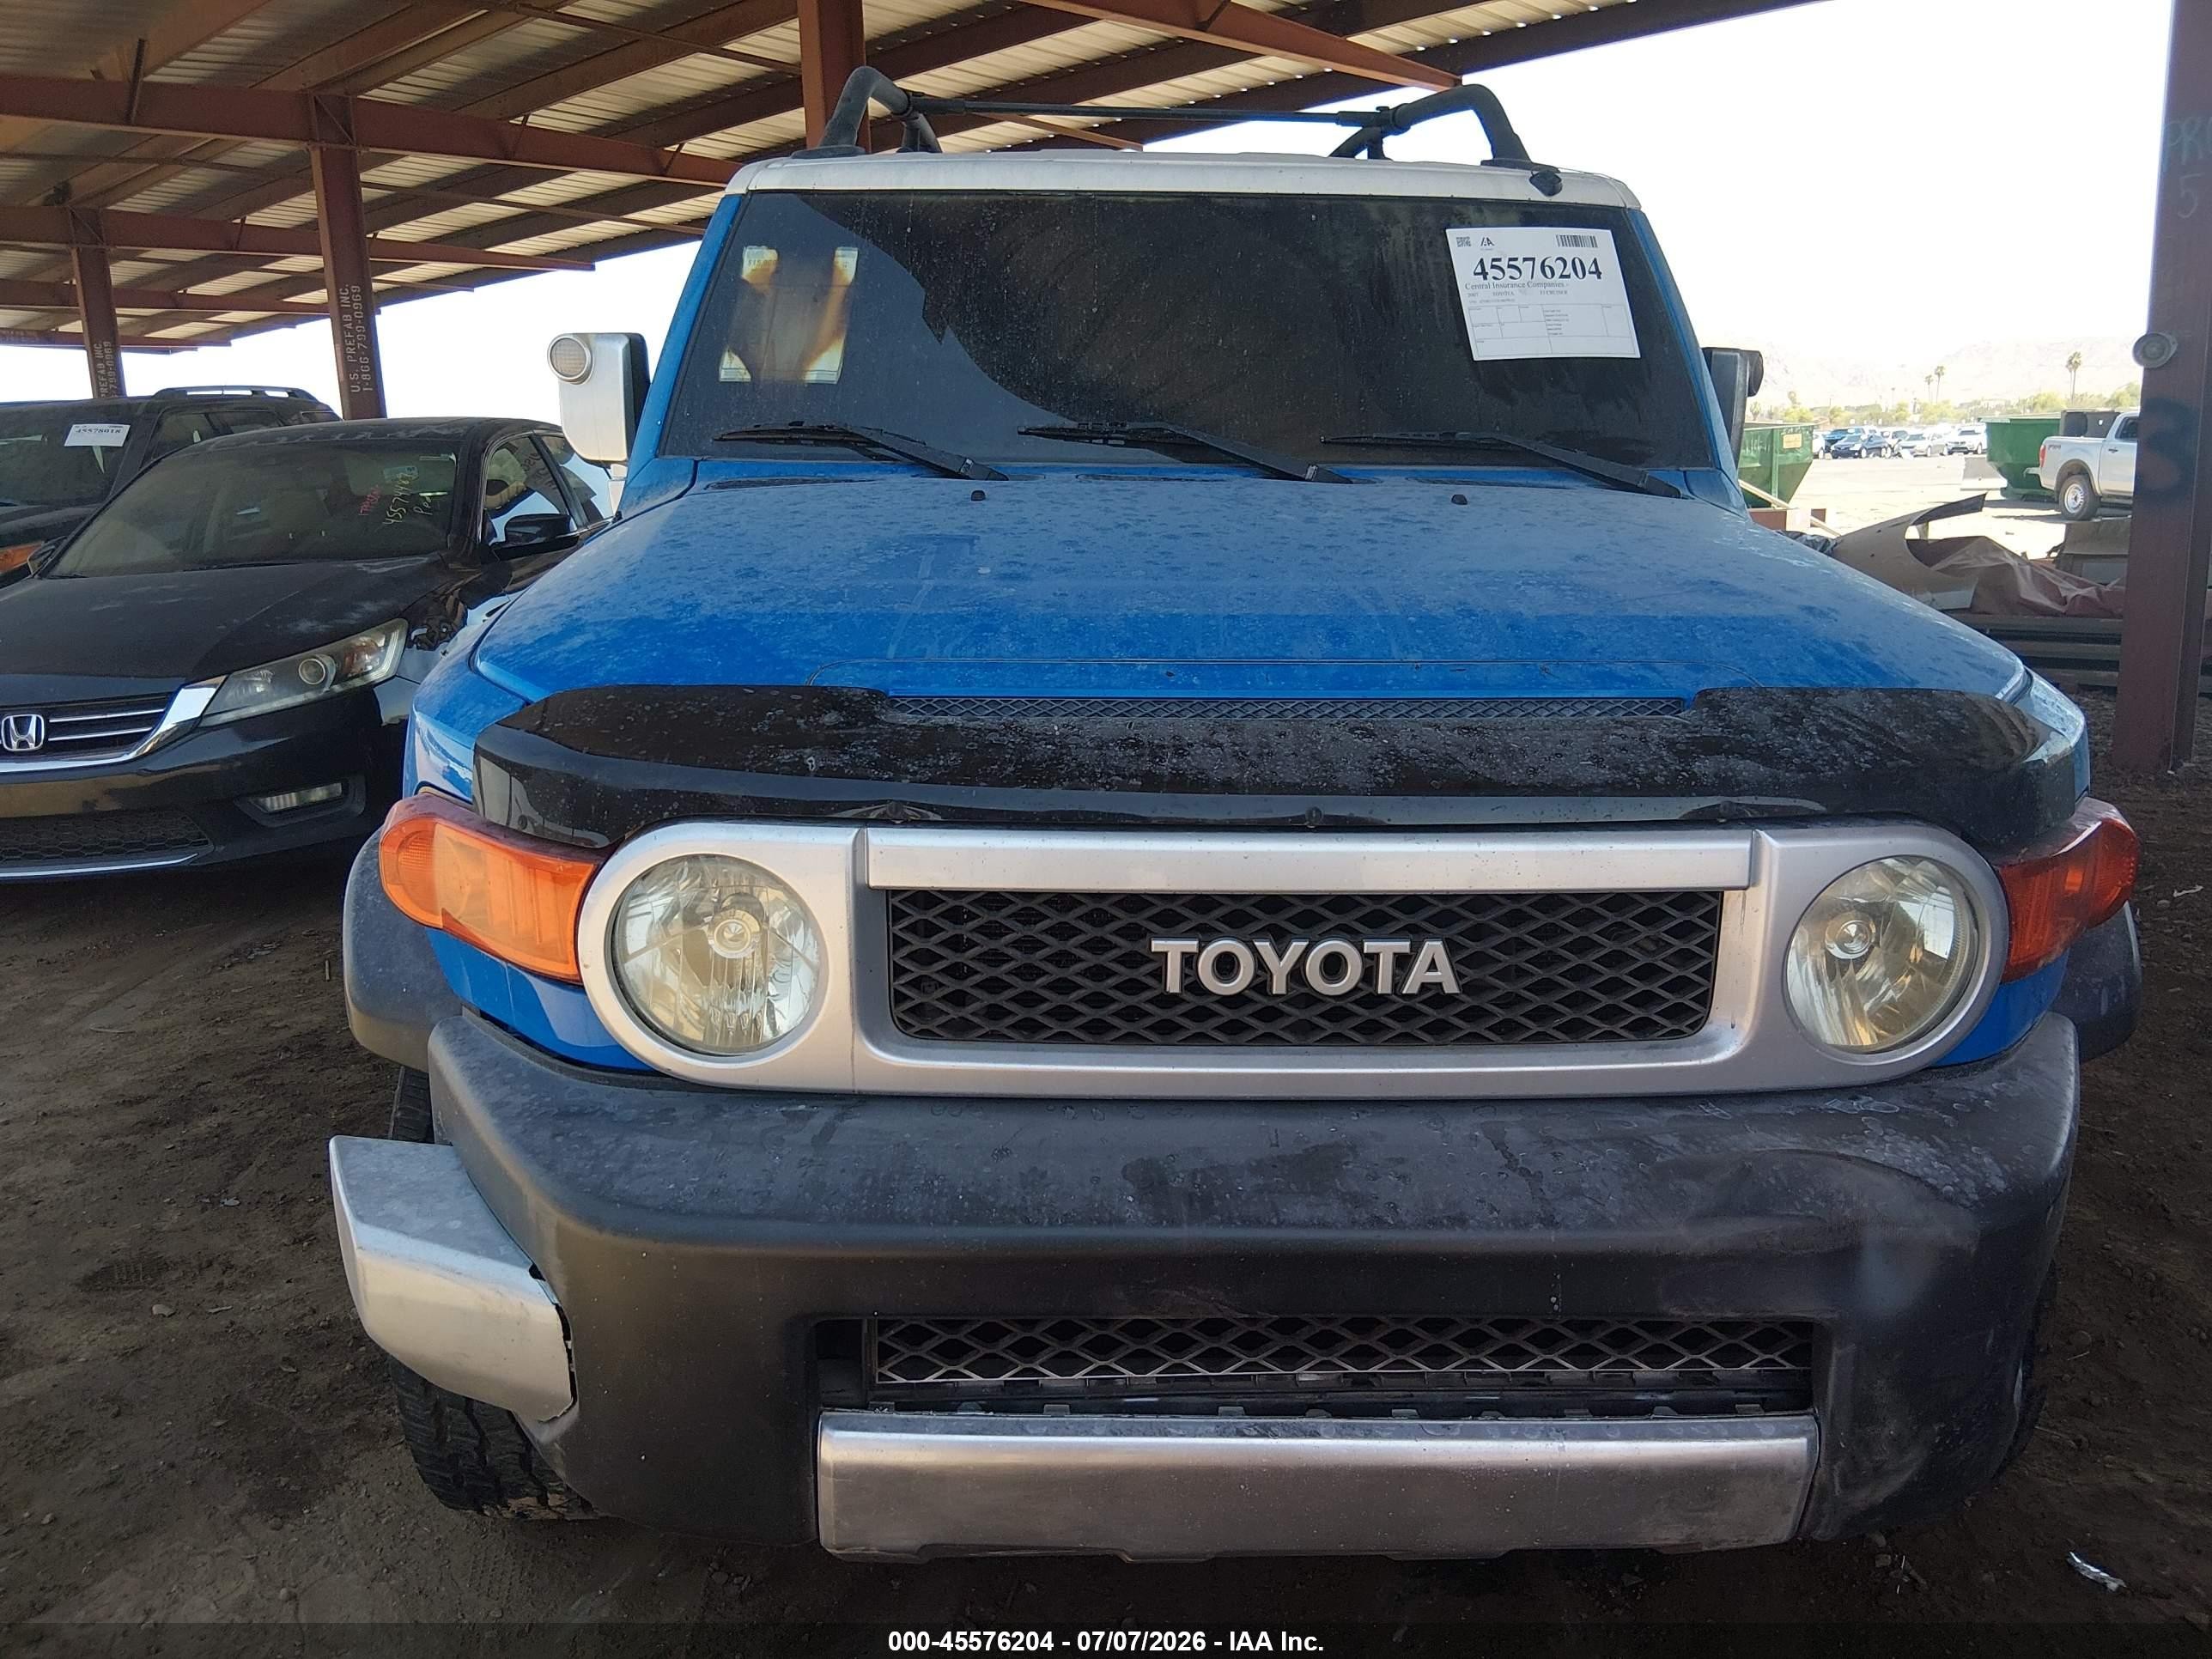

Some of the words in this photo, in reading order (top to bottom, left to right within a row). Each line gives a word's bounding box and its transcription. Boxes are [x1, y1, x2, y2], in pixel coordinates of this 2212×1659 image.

[1473, 256, 1602, 281] 45576204
[339, 284, 351, 307] INC.
[1465, 282, 1491, 290] Central
[1492, 281, 1526, 289] Insurance
[1527, 281, 1565, 289] Companies
[343, 314, 358, 362] PREFAB
[351, 285, 373, 392] 1-866-799-0969
[349, 369, 362, 392] U.S.
[1151, 937, 1461, 996] TOYOTA
